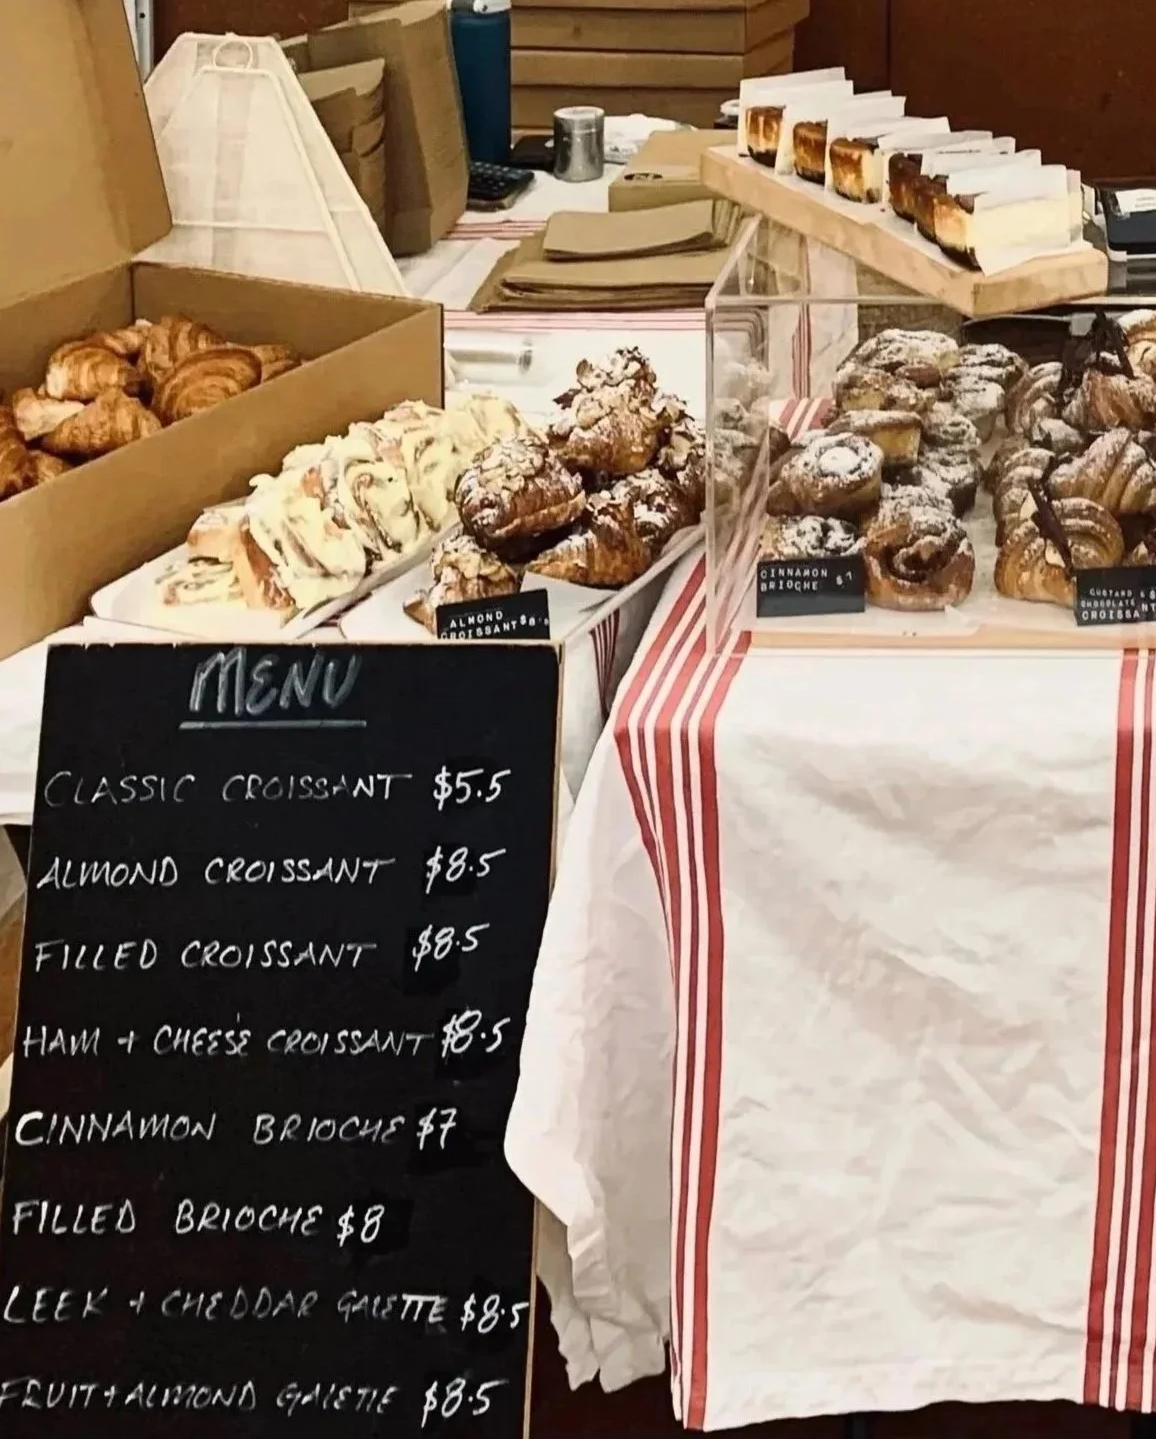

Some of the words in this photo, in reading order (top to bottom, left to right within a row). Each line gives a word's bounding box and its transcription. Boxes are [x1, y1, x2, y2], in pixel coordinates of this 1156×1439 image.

[760, 567, 829, 580] CINNAMON
[760, 580, 819, 593] BRIOCHE
[1089, 587, 1133, 598] CUSTARD
[449, 610, 504, 629] ALMOND
[1080, 598, 1136, 609] CHOCOLATE
[440, 620, 518, 640] CROISSANT
[188, 646, 362, 717] MENU
[43, 770, 196, 805] CLASSIC
[221, 772, 414, 802] CROISSANT
[431, 765, 512, 811] $5.5
[36, 855, 180, 889] ALMOND
[204, 857, 397, 887] CROISSANT
[425, 847, 507, 894] $8.5
[34, 938, 158, 973] FILLED
[180, 939, 377, 970] CROISSANT
[412, 923, 491, 973] $8.5
[22, 1025, 102, 1059] HAM
[153, 1023, 253, 1056] CHEESE
[266, 1028, 435, 1057] CROISSANT
[441, 1008, 512, 1064] $8.5
[14, 1109, 218, 1147] CINNAMON
[253, 1112, 406, 1145] BRIOCHE
[416, 1107, 458, 1151] $7
[11, 1198, 138, 1236] FILLED
[174, 1197, 324, 1236] BRIOCHE
[336, 1203, 386, 1248] $8
[2, 1284, 108, 1325] LEEK
[161, 1286, 319, 1321] CHEDDAR
[337, 1290, 448, 1324] GALETTE
[460, 1293, 530, 1335] $8.5
[276, 1381, 399, 1418] GALETTE
[420, 1376, 510, 1429] $8.5
